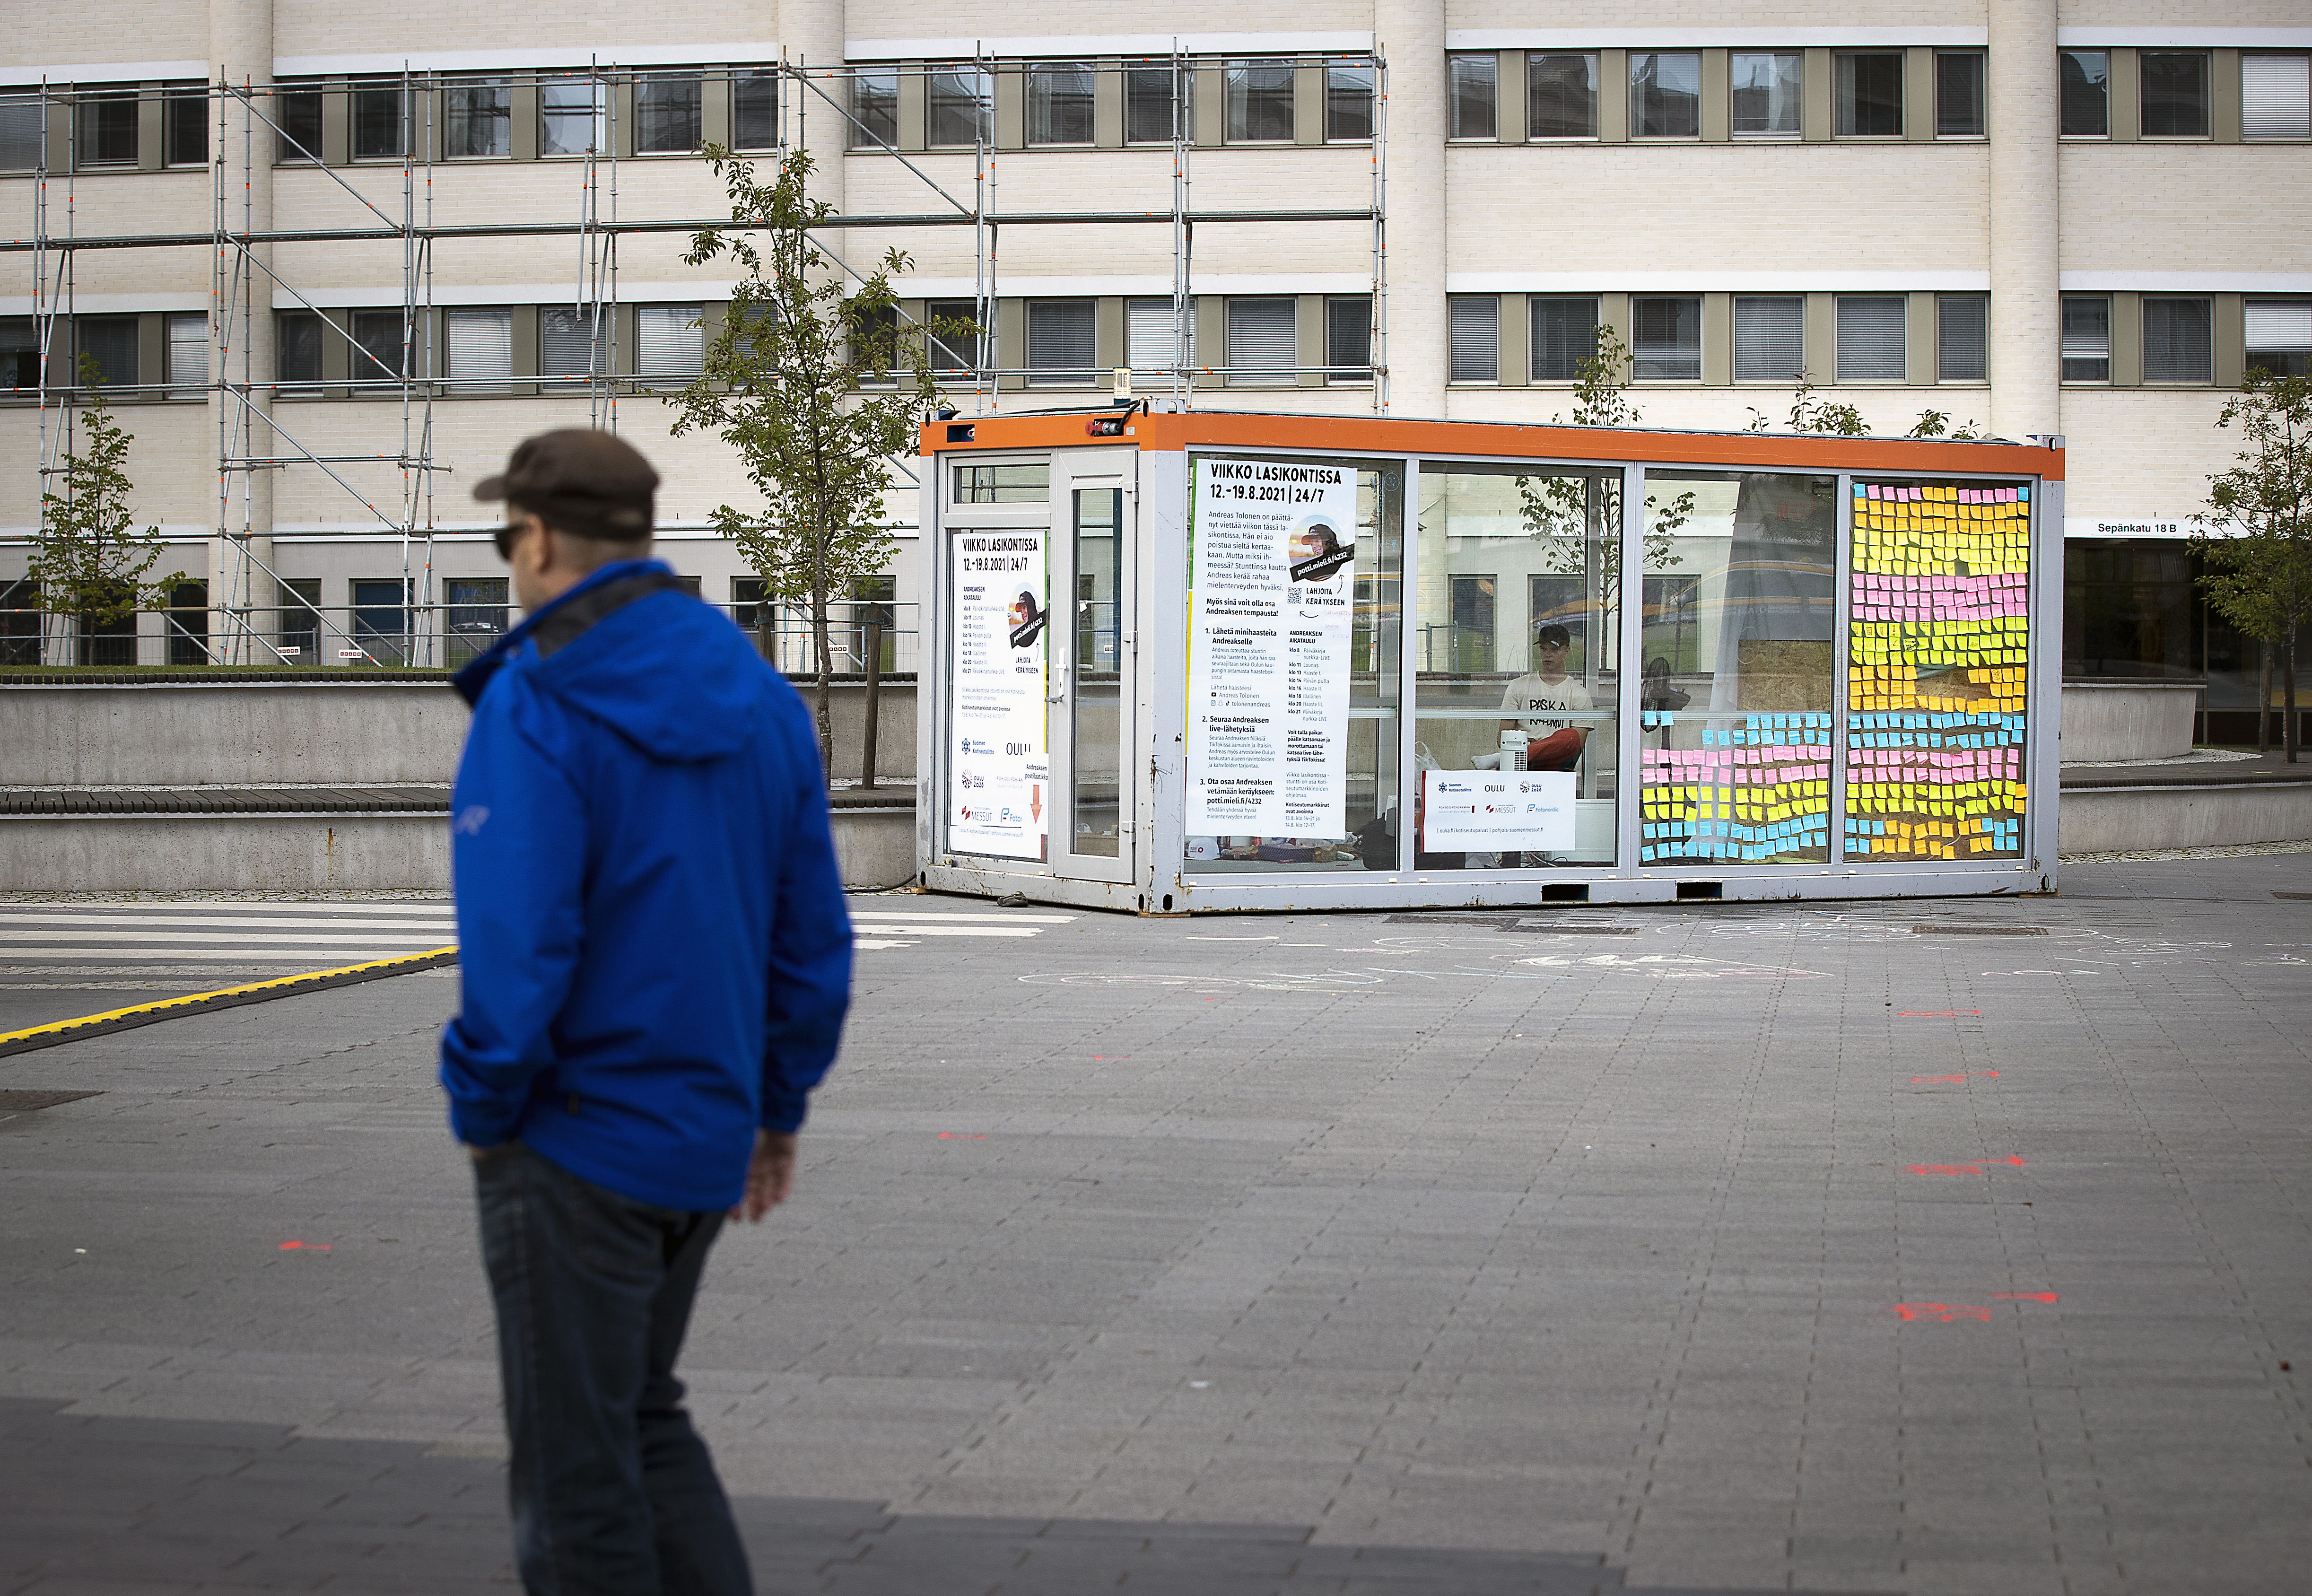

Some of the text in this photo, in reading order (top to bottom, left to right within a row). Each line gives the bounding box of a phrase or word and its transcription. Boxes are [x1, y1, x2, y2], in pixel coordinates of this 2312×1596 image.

[1211, 463, 1341, 484] VIIKKO LASIKONTISSA
[1210, 484, 1324, 503] 12.-19.8.2021 24/7
[1272, 514, 1293, 522] päättä-
[1220, 521, 1241, 529] viettää
[2098, 523, 2176, 534] Sepänkatu 18 B
[1208, 531, 1240, 539] sikontissa.
[963, 538, 1038, 552] VIIKKO LASIKONTISSA
[1208, 541, 1231, 549] poistua
[963, 557, 1028, 571] 12.-19.8.2021 24/7
[1297, 551, 1348, 577] potti.mieli.fi/4232
[1207, 581, 1283, 592] mielenterveyden hyväksi.
[1206, 598, 1223, 606] Myös
[1306, 598, 1344, 606] KERÄYKSEEN
[1244, 609, 1278, 618] tempausta!
[1212, 637, 1253, 645] Andreakselle
[1209, 724, 1255, 734] live-lähetyksiä
[1239, 787, 1274, 795] keräykseen:
[1207, 797, 1262, 805] potti.mieli.fi/4232
[971, 811, 992, 821] MESSUT
